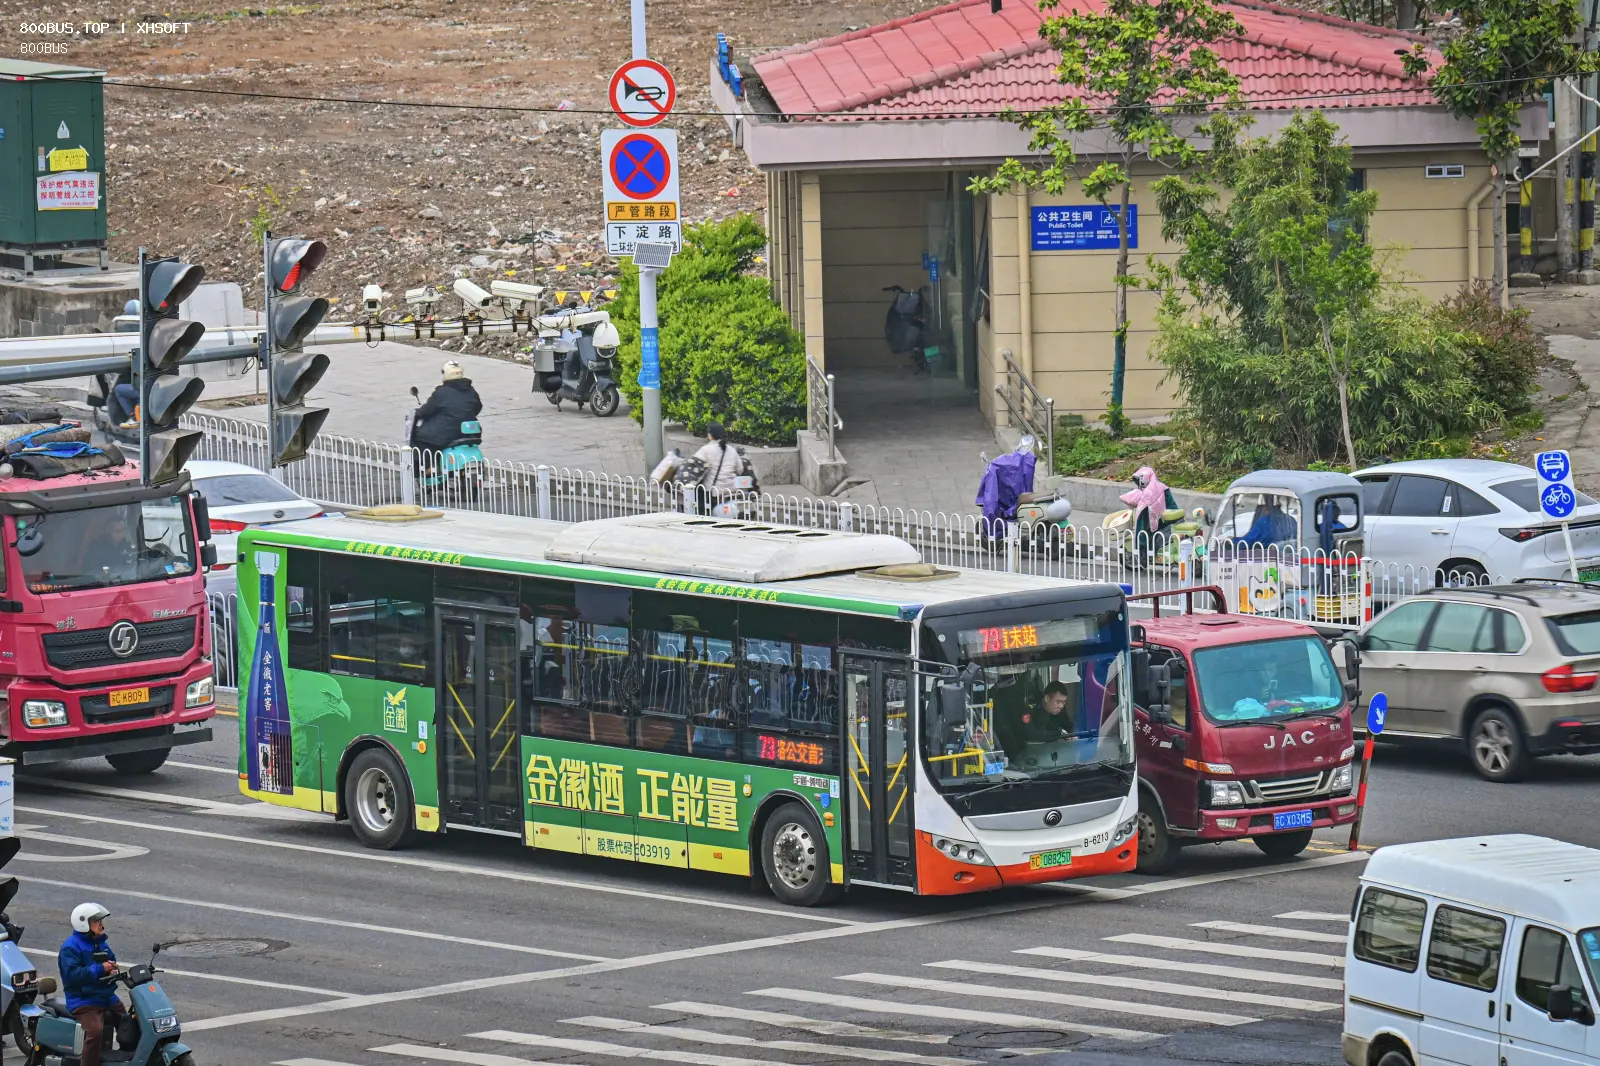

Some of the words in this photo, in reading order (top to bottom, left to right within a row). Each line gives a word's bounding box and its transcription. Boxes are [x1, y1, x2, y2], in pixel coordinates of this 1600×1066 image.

[40, 180, 95, 189] 保护燃气莫违法
[614, 205, 671, 218] 严管路段
[1037, 211, 1093, 222] 公共卫生间
[613, 225, 672, 239] 下淀路
[979, 627, 1001, 653] 73
[758, 735, 777, 760] 73
[1263, 731, 1315, 750] JAC
[526, 754, 625, 815] 金徽酒
[636, 767, 740, 832] 正能量
[1083, 832, 1109, 848] B-6213
